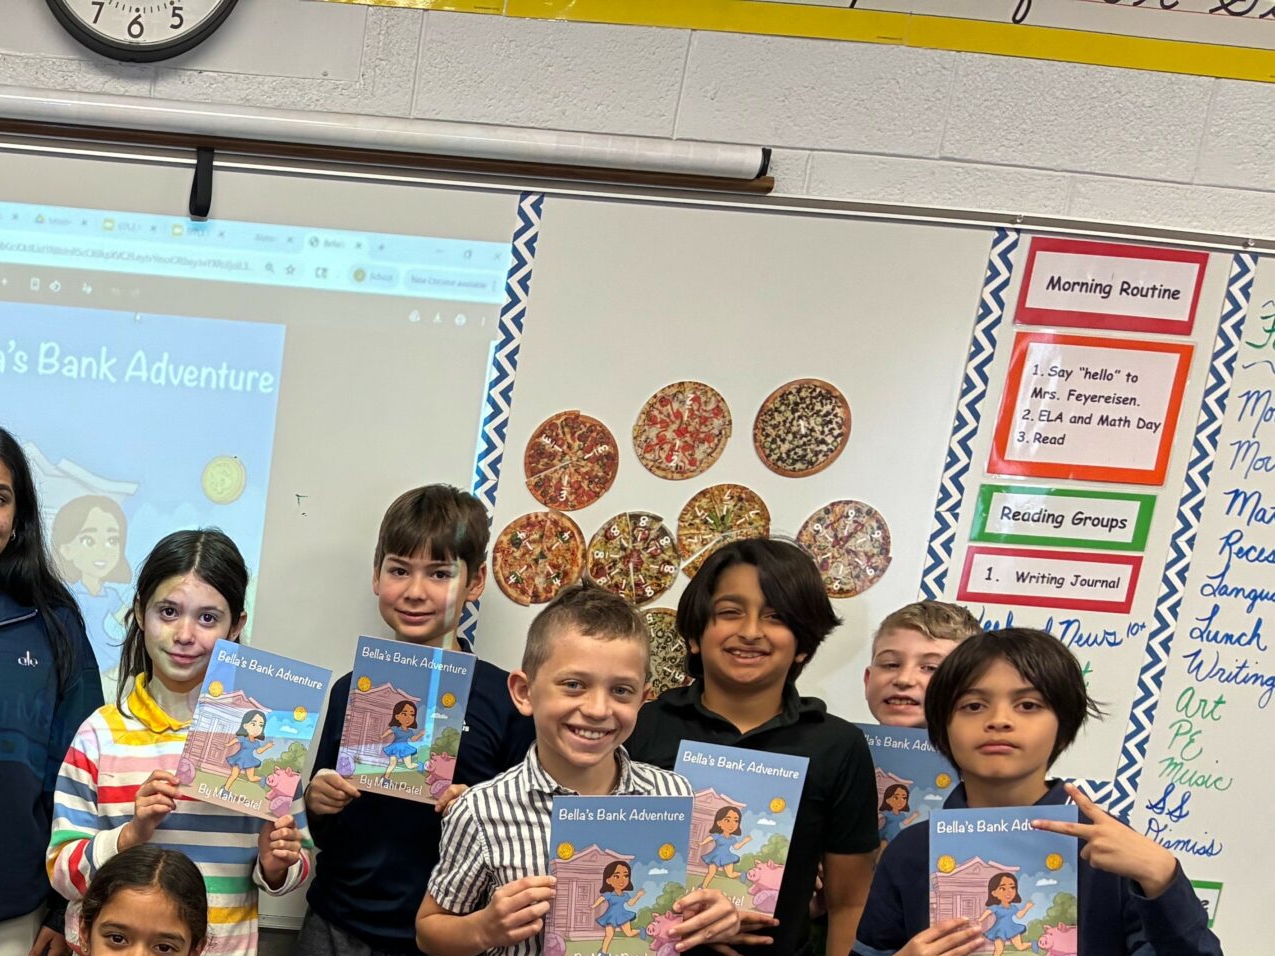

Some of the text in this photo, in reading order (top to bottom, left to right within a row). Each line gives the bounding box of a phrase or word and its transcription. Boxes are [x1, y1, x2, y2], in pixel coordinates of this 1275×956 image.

[91, 1, 105, 24] 7
[170, 6, 183, 30] 5
[127, 14, 144, 38] 6
[1046, 276, 1181, 300] Morning Routine
[38, 341, 117, 383] Bank
[125, 350, 274, 394] Adventure
[1032, 364, 1044, 376] 1.
[1048, 366, 1073, 382] Say
[1126, 372, 1138, 383] to
[1031, 387, 1140, 406] Mrs. Feyereisen.
[1022, 410, 1161, 433] 2. ELA and Math Day
[1017, 431, 1066, 446] 3. Read
[1000, 506, 1127, 532] Reading Groups
[985, 567, 1120, 589] 1. Writing Journal
[1190, 604, 1267, 651] Lunch
[217, 650, 322, 689] Bella's Bank Adventure
[362, 647, 467, 675] Bella's Bank Adventure
[1182, 649, 1275, 708] Writing
[1176, 687, 1226, 721] Art
[884, 737, 909, 750] Bank
[1168, 719, 1203, 761] PE
[683, 751, 799, 779] Bella's Bank Adventure
[1158, 757, 1233, 791] Music
[399, 783, 422, 795] Patel
[237, 795, 262, 810] Patel
[1146, 783, 1192, 822] SS
[559, 809, 685, 822] Bella's Bank Adventure
[937, 821, 974, 833] Bella's
[977, 820, 1008, 832] Bank
